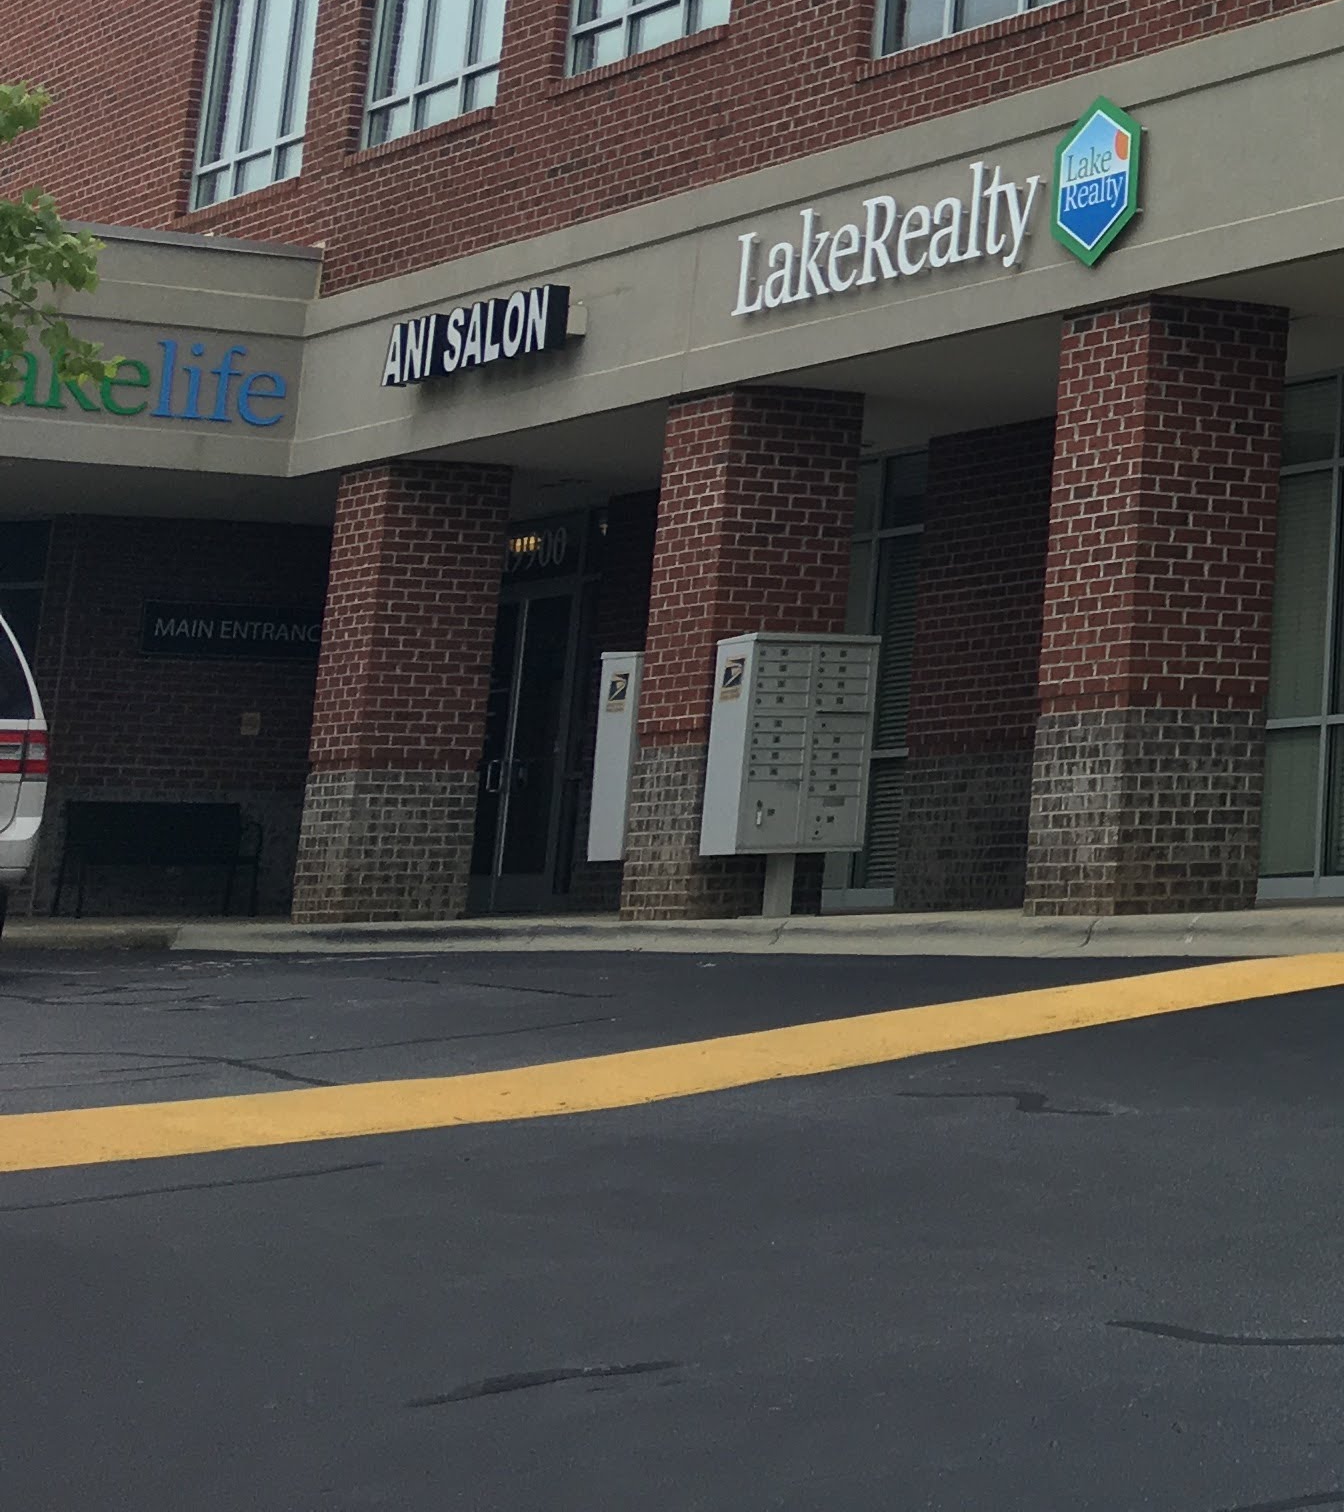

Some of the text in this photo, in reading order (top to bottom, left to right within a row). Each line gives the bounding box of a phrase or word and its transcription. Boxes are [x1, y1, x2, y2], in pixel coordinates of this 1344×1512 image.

[1066, 147, 1112, 183] Lake
[1064, 175, 1124, 212] Realty
[731, 161, 1040, 317] LakeRealty
[382, 285, 549, 386] ANI SALON
[154, 618, 213, 638] MAIN
